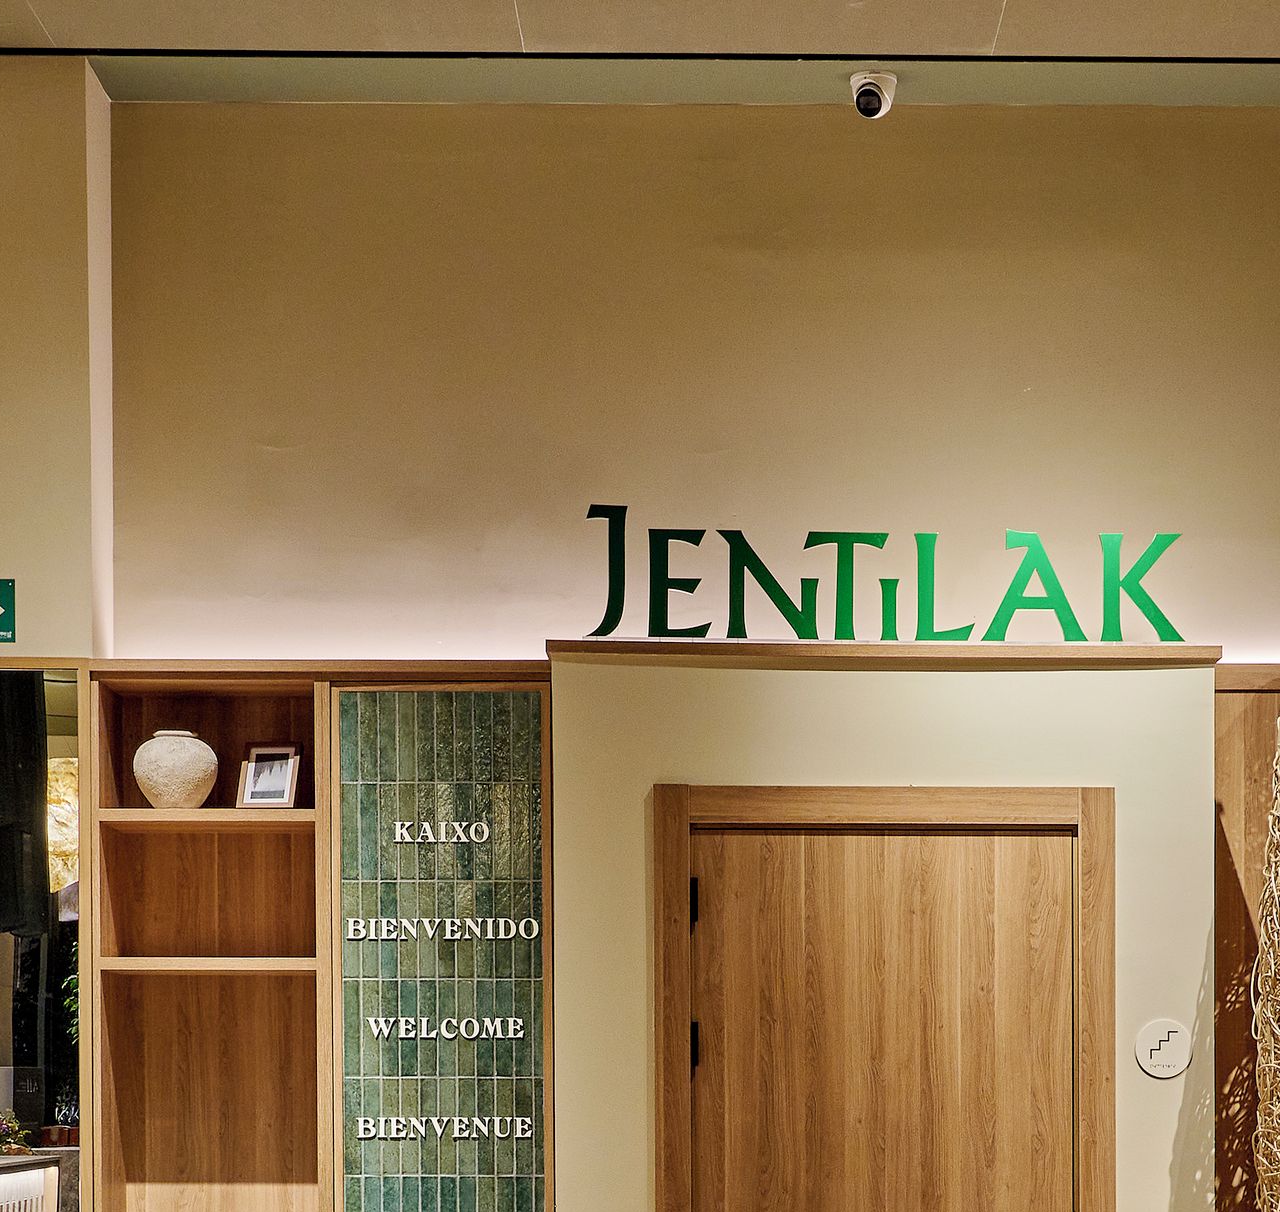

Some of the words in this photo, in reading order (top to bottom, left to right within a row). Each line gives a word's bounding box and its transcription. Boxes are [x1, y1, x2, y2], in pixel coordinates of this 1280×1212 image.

[585, 503, 1186, 643] JENTILAK
[392, 820, 490, 844] KAIXO
[346, 917, 540, 941] BIENVENIDO
[366, 1016, 526, 1040] WELCOME
[355, 1117, 534, 1140] BIENVENUE
